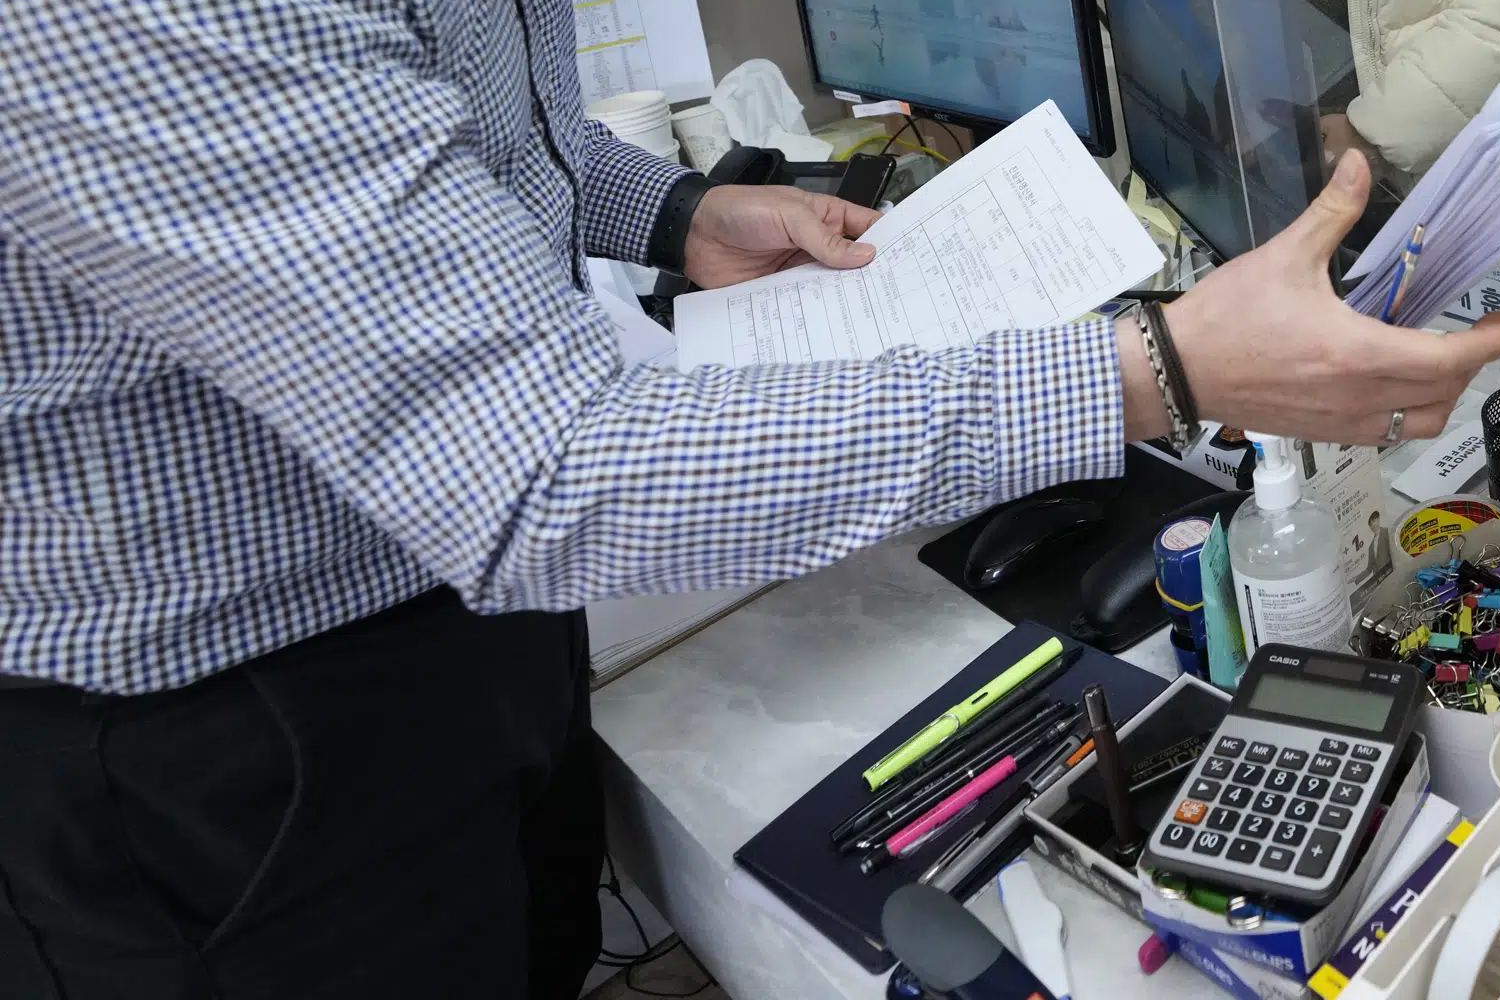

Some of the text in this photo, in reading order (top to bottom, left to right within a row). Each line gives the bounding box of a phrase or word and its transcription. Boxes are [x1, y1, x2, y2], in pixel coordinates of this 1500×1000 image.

[1435, 436, 1478, 468] COFFEE
[1439, 437, 1486, 477] AMMOTH
[1429, 528, 1439, 536] 3M
[1440, 524, 1462, 533] Scotch
[1269, 655, 1300, 667] CASIO
[1221, 739, 1238, 750] MC
[1252, 745, 1268, 756] MR
[1357, 746, 1373, 756] MU
[1315, 757, 1333, 768] M+
[1242, 765, 1255, 779] 7
[1274, 773, 1287, 786] 8
[1307, 779, 1319, 792] 9
[1229, 788, 1241, 802] 4
[1261, 794, 1273, 808] 5
[1294, 801, 1306, 815] 6
[1219, 811, 1228, 825] 1
[1248, 818, 1261, 832] 2
[1170, 827, 1183, 841] 0
[1282, 825, 1295, 839] 3
[1200, 834, 1219, 849] 00
[1252, 949, 1295, 972] CLIPS
